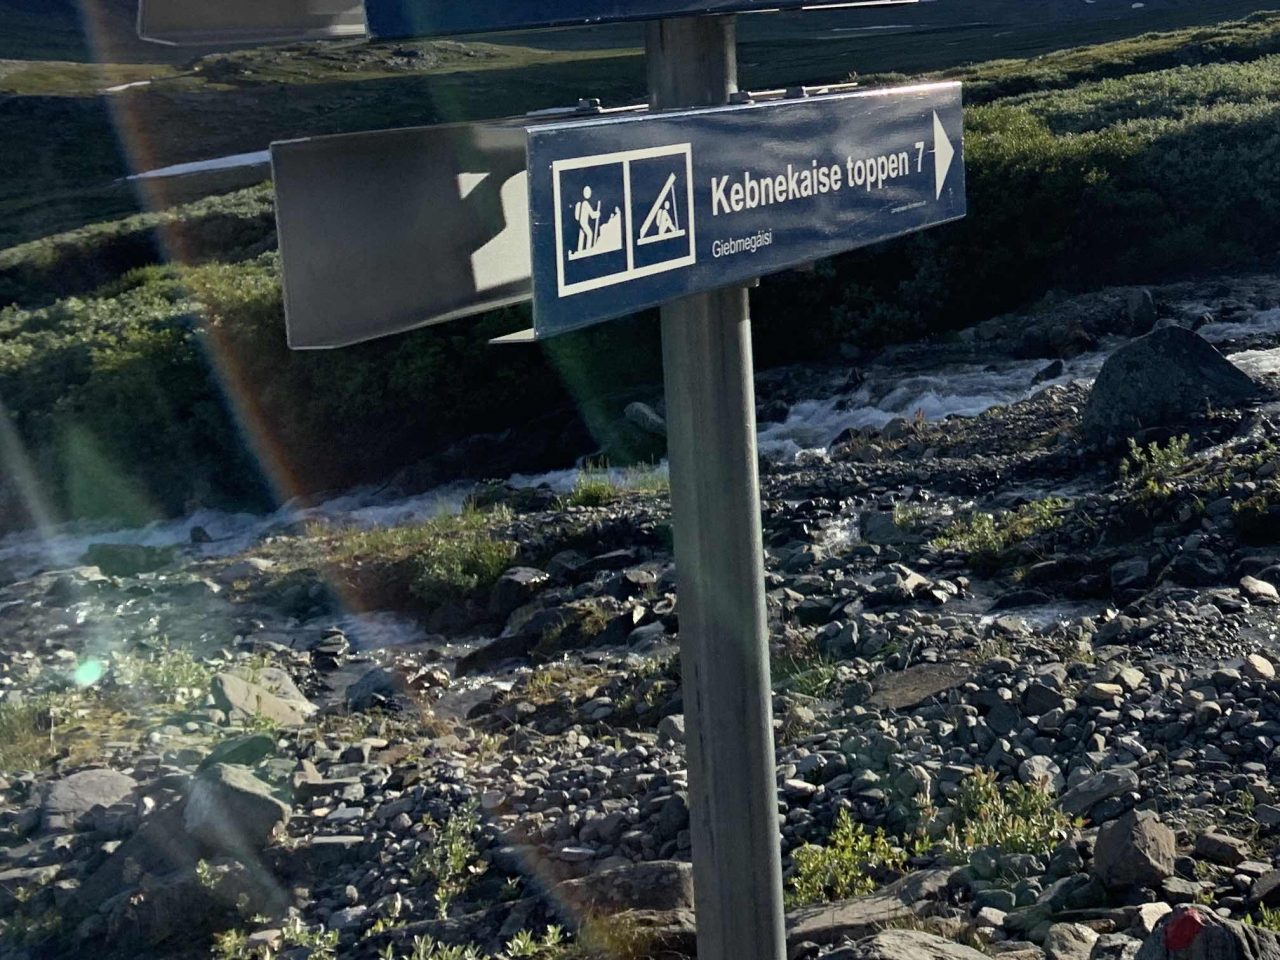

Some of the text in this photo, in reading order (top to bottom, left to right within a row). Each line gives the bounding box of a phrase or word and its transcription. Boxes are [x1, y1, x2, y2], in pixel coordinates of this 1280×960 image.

[711, 141, 925, 216] Kebnekaise toppen 7
